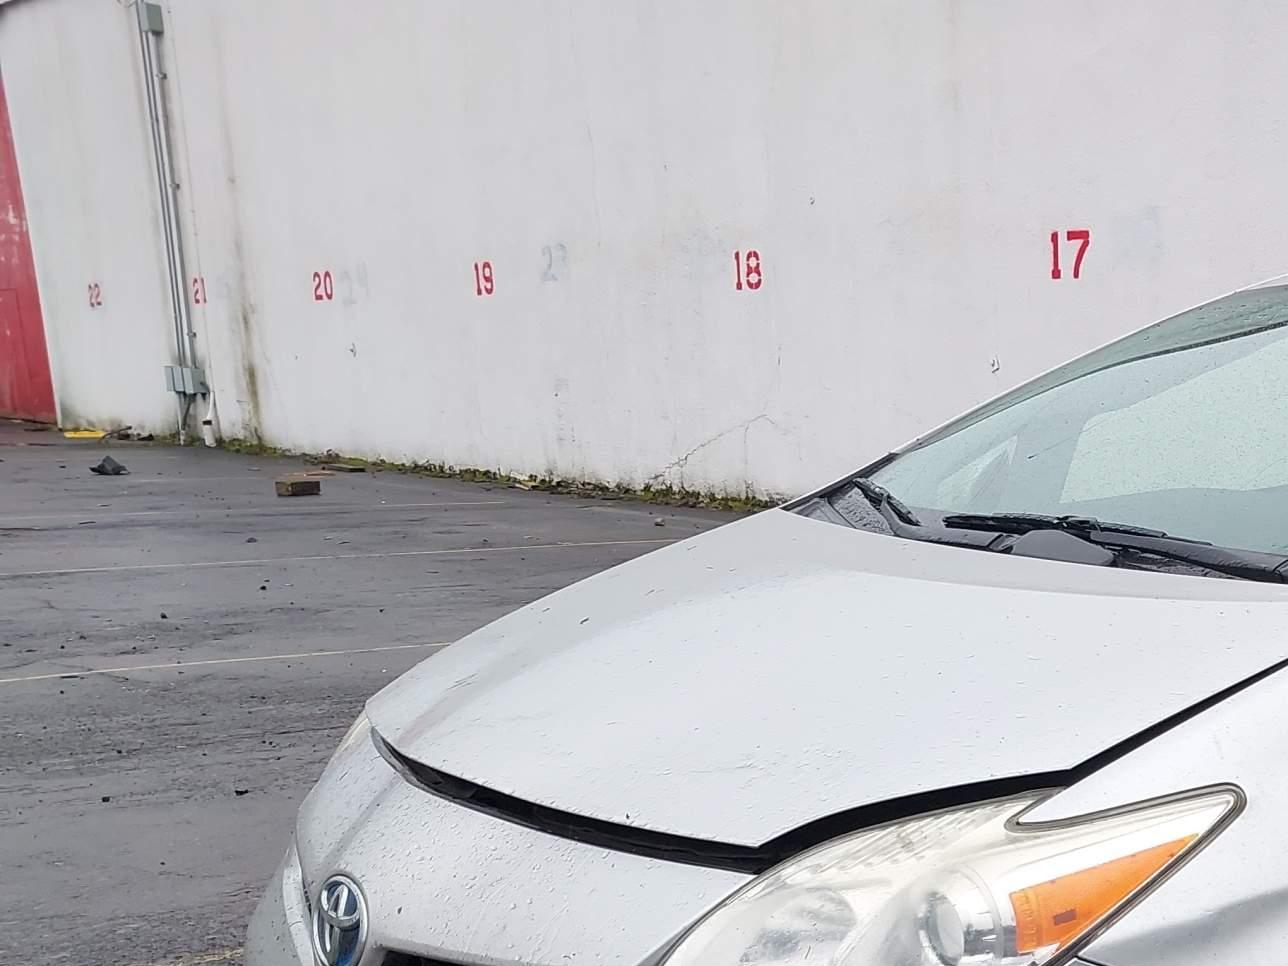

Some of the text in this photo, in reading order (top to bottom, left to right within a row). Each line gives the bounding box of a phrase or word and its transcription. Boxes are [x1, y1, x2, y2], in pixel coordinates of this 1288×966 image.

[733, 249, 763, 291] 18
[1050, 229, 1090, 280] 17
[88, 282, 103, 308] 22
[193, 277, 207, 304] 21
[312, 269, 334, 301] 20
[473, 260, 494, 297] 19
